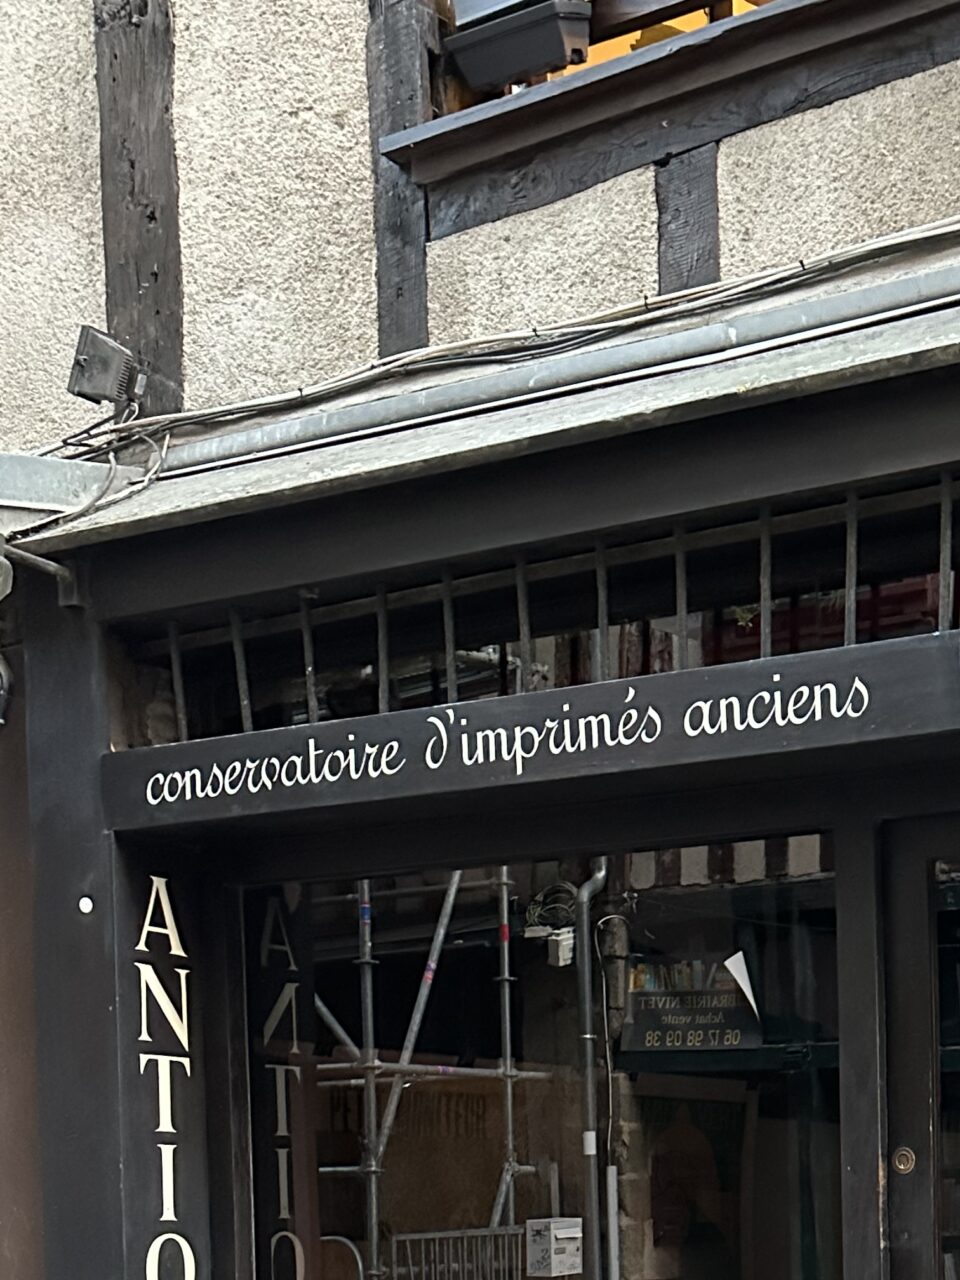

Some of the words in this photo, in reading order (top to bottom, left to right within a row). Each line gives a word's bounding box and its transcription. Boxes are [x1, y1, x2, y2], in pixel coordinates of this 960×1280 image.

[146, 734, 407, 806] conservatoire
[421, 686, 662, 776] d'imprimés
[683, 673, 869, 737] anciens
